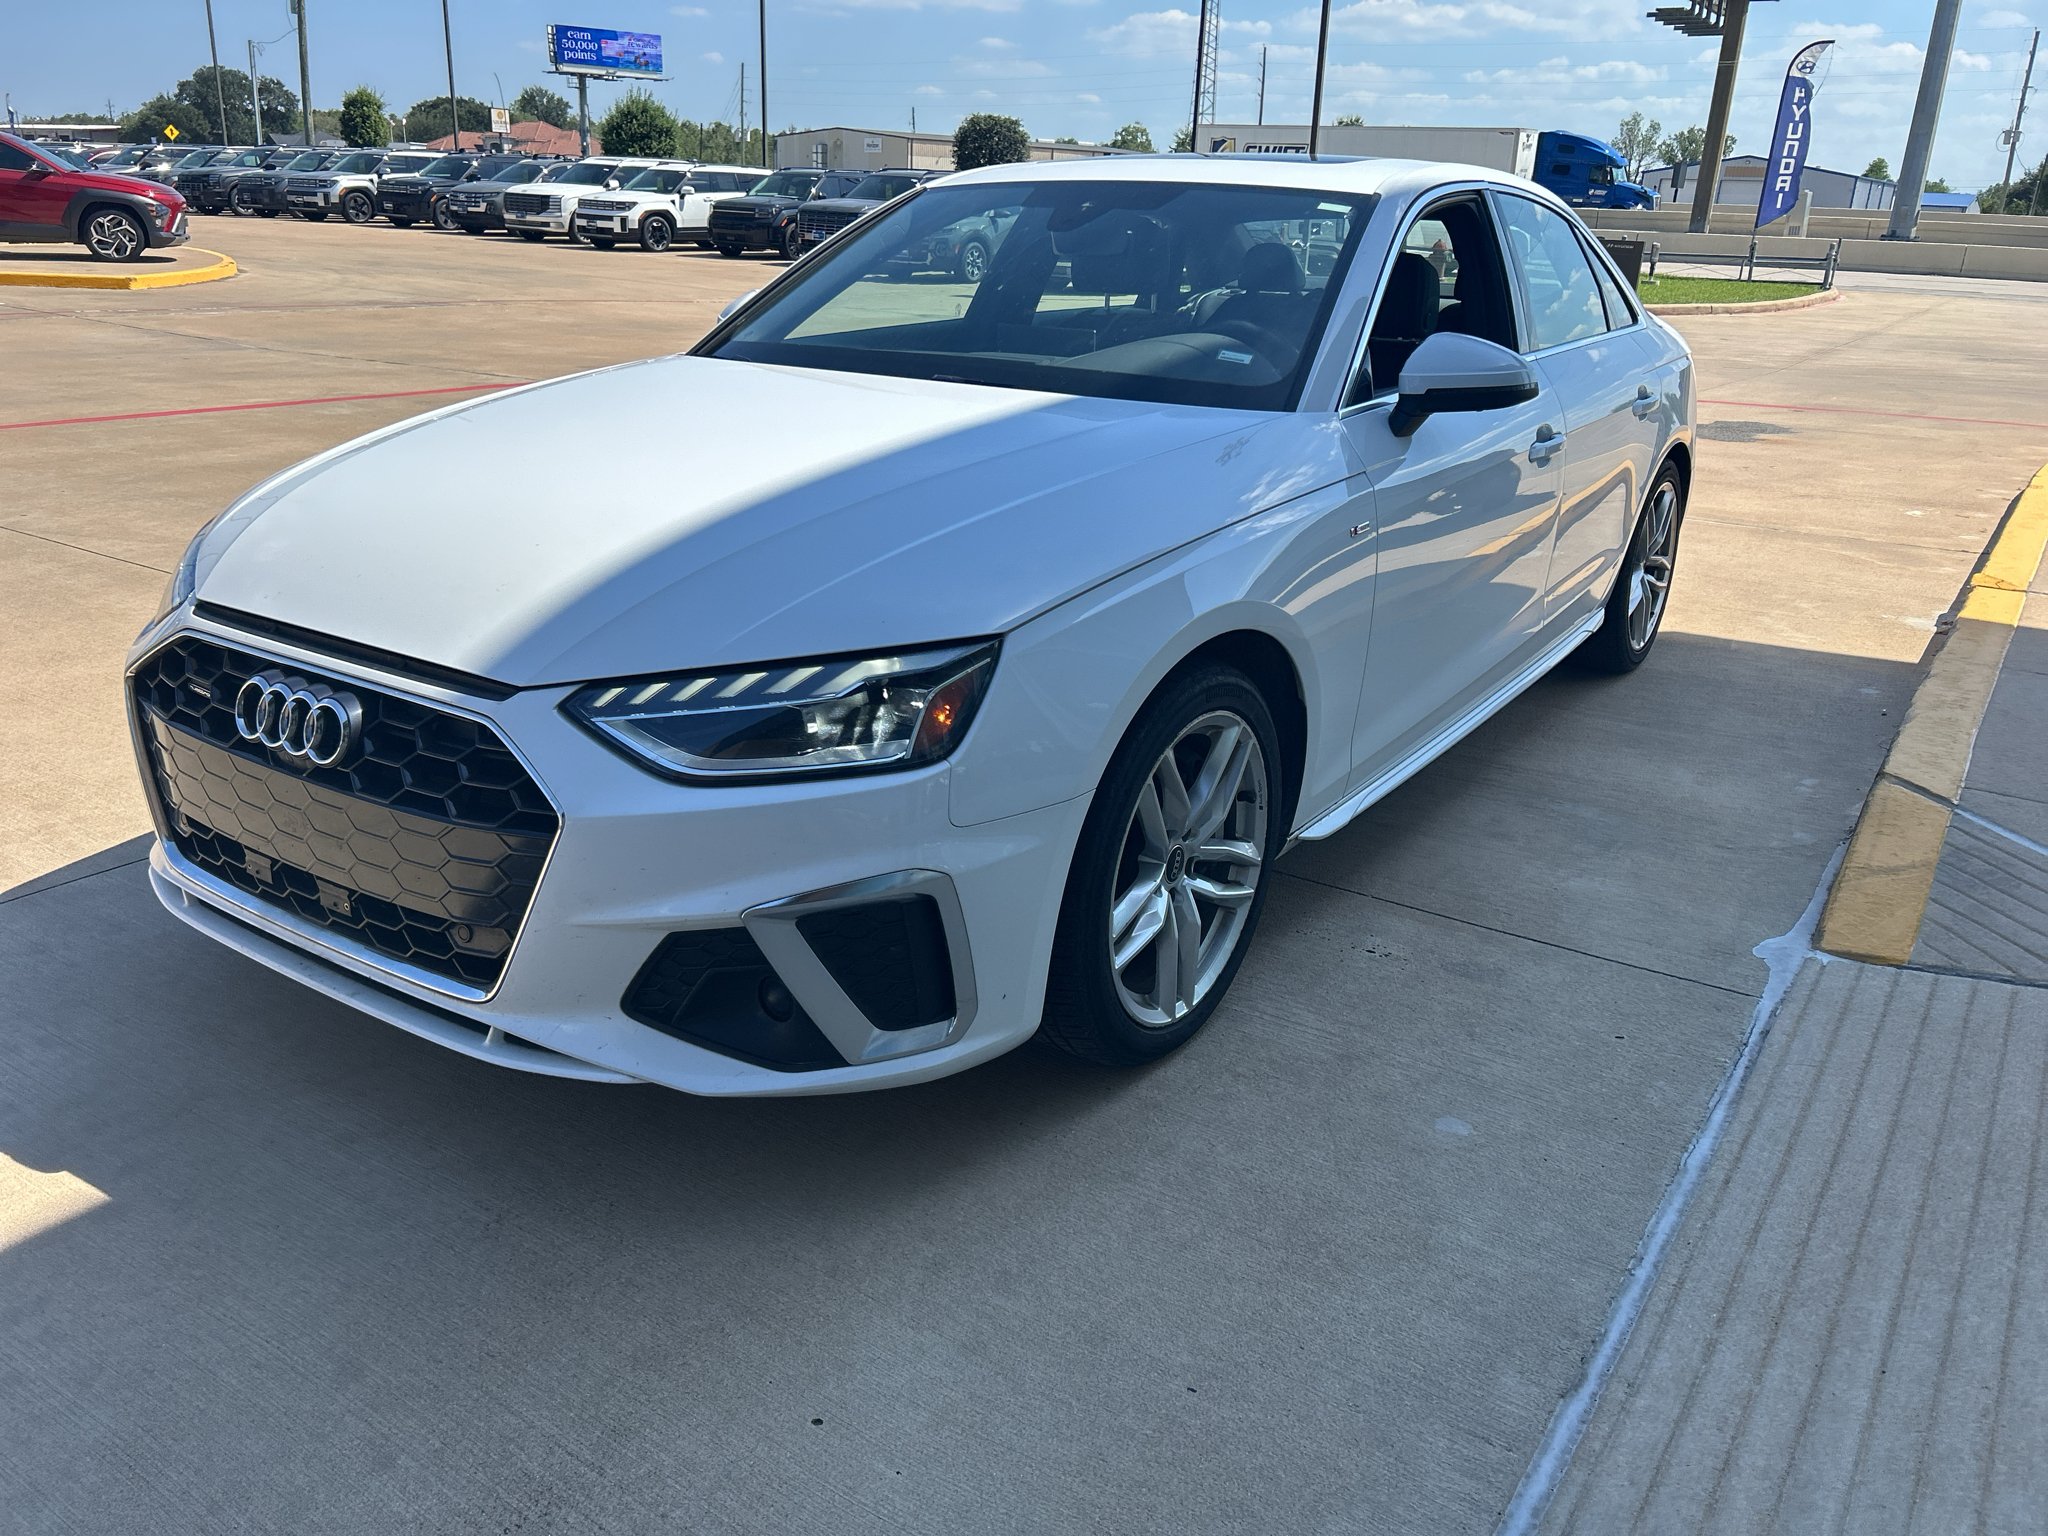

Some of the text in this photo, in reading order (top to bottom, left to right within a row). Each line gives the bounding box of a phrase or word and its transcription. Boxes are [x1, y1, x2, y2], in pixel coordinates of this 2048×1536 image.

[567, 30, 591, 40] earn
[561, 39, 598, 50] 50,000
[564, 49, 597, 60] points
[1776, 86, 1807, 209] HYUNDAI
